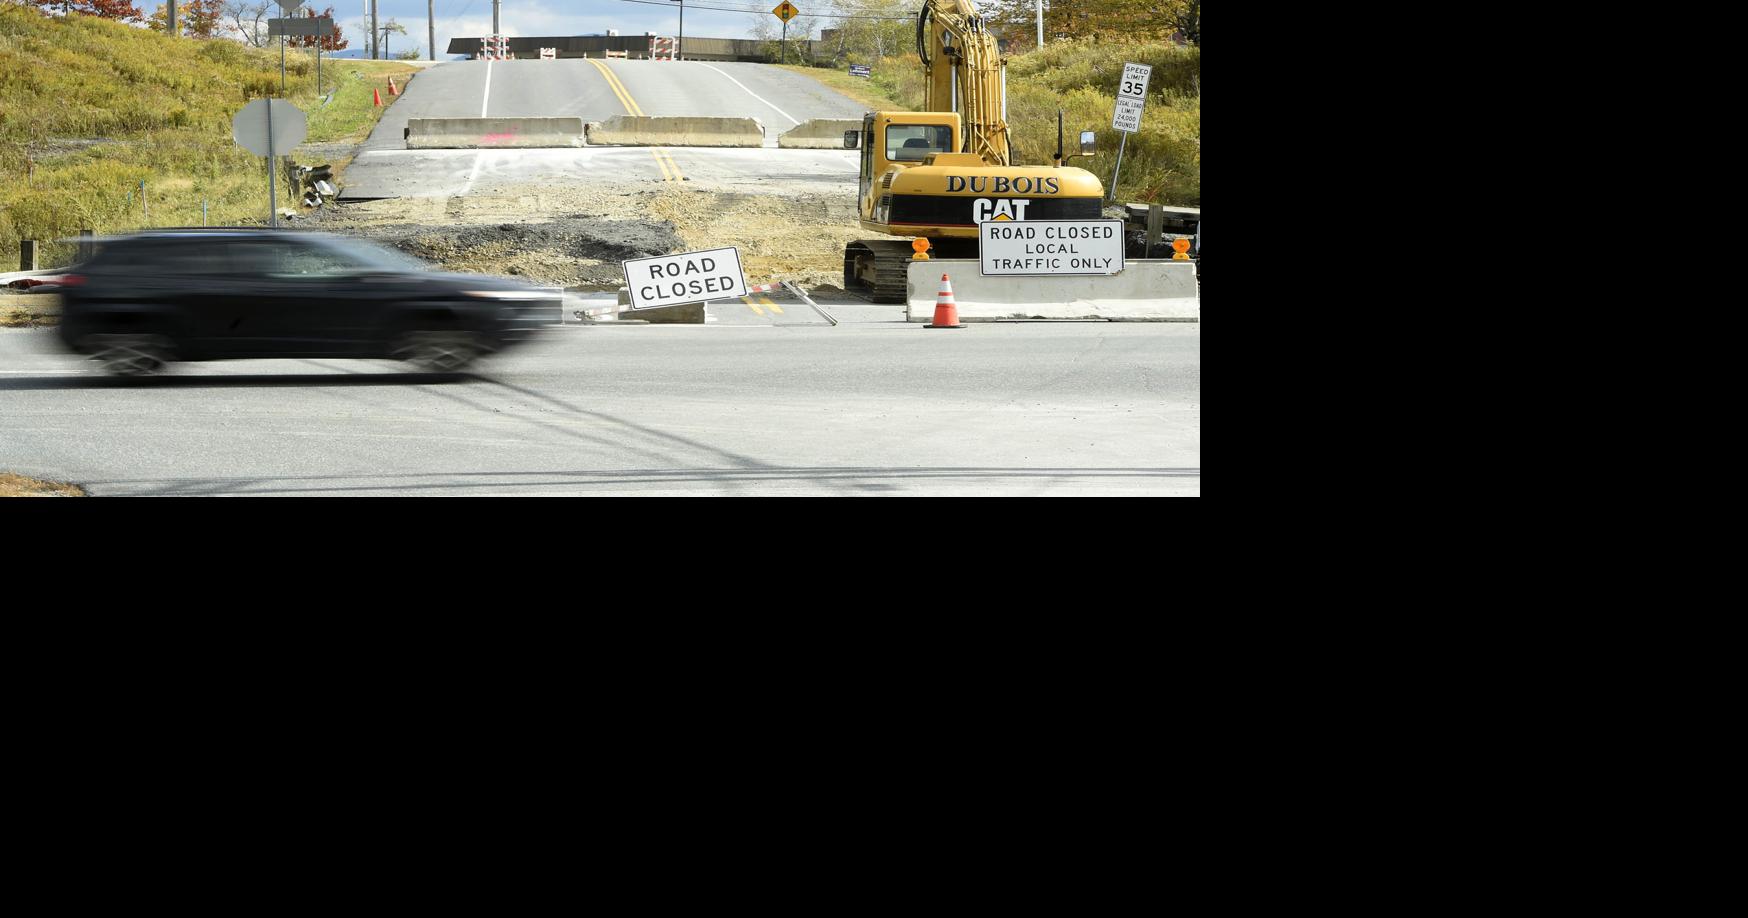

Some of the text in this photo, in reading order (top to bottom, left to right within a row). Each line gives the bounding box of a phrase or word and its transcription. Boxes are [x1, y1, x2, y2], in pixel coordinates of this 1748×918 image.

[1126, 66, 1148, 75] SPEED
[1122, 81, 1143, 95] 35
[1115, 120, 1136, 129] POUNDS
[973, 198, 1030, 225] CAT
[990, 226, 1113, 240] ROAD CLOSED
[1025, 243, 1079, 255] LOCAL
[649, 257, 716, 279] ROAD
[992, 257, 1112, 269] TRAFFIC ONLY
[640, 275, 734, 301] CLOSED
